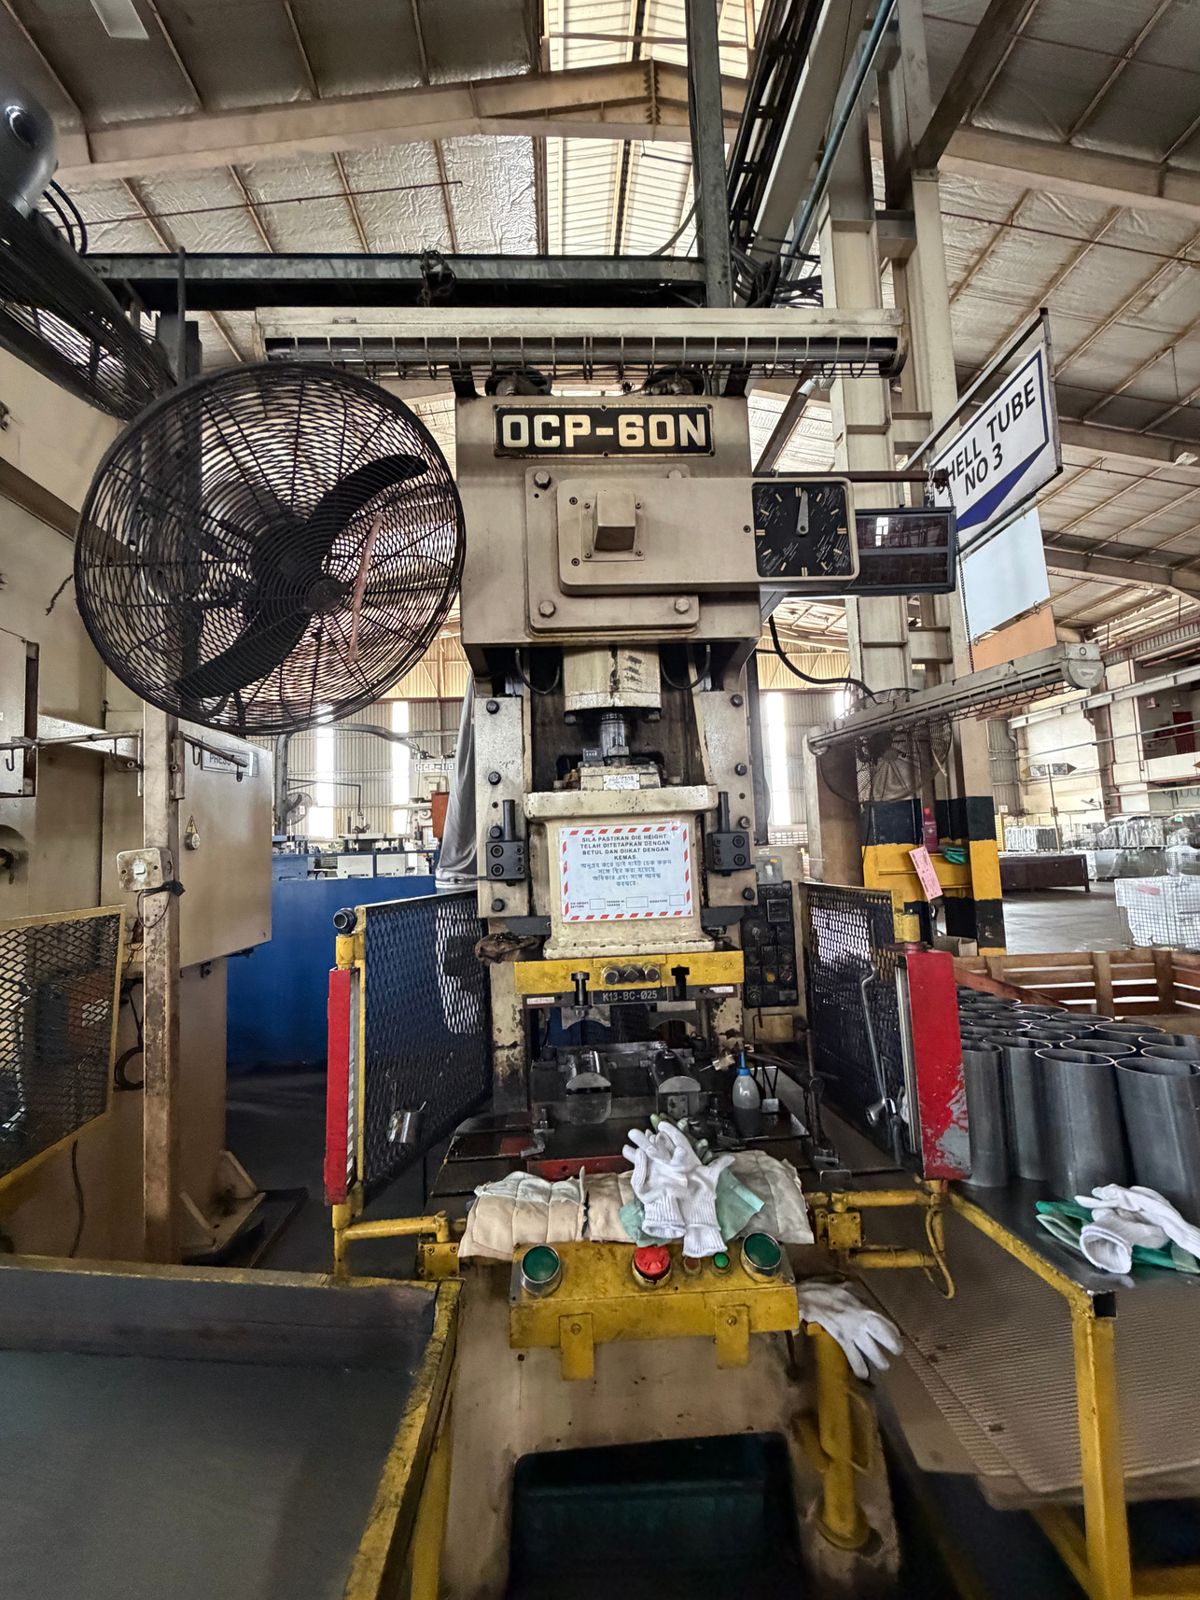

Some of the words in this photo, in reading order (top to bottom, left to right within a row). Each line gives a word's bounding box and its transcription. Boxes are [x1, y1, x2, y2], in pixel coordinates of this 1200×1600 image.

[502, 414, 706, 448] OCP-60N
[986, 376, 1036, 443] TUBE
[965, 456, 989, 496] NO
[992, 442, 1003, 471] 3
